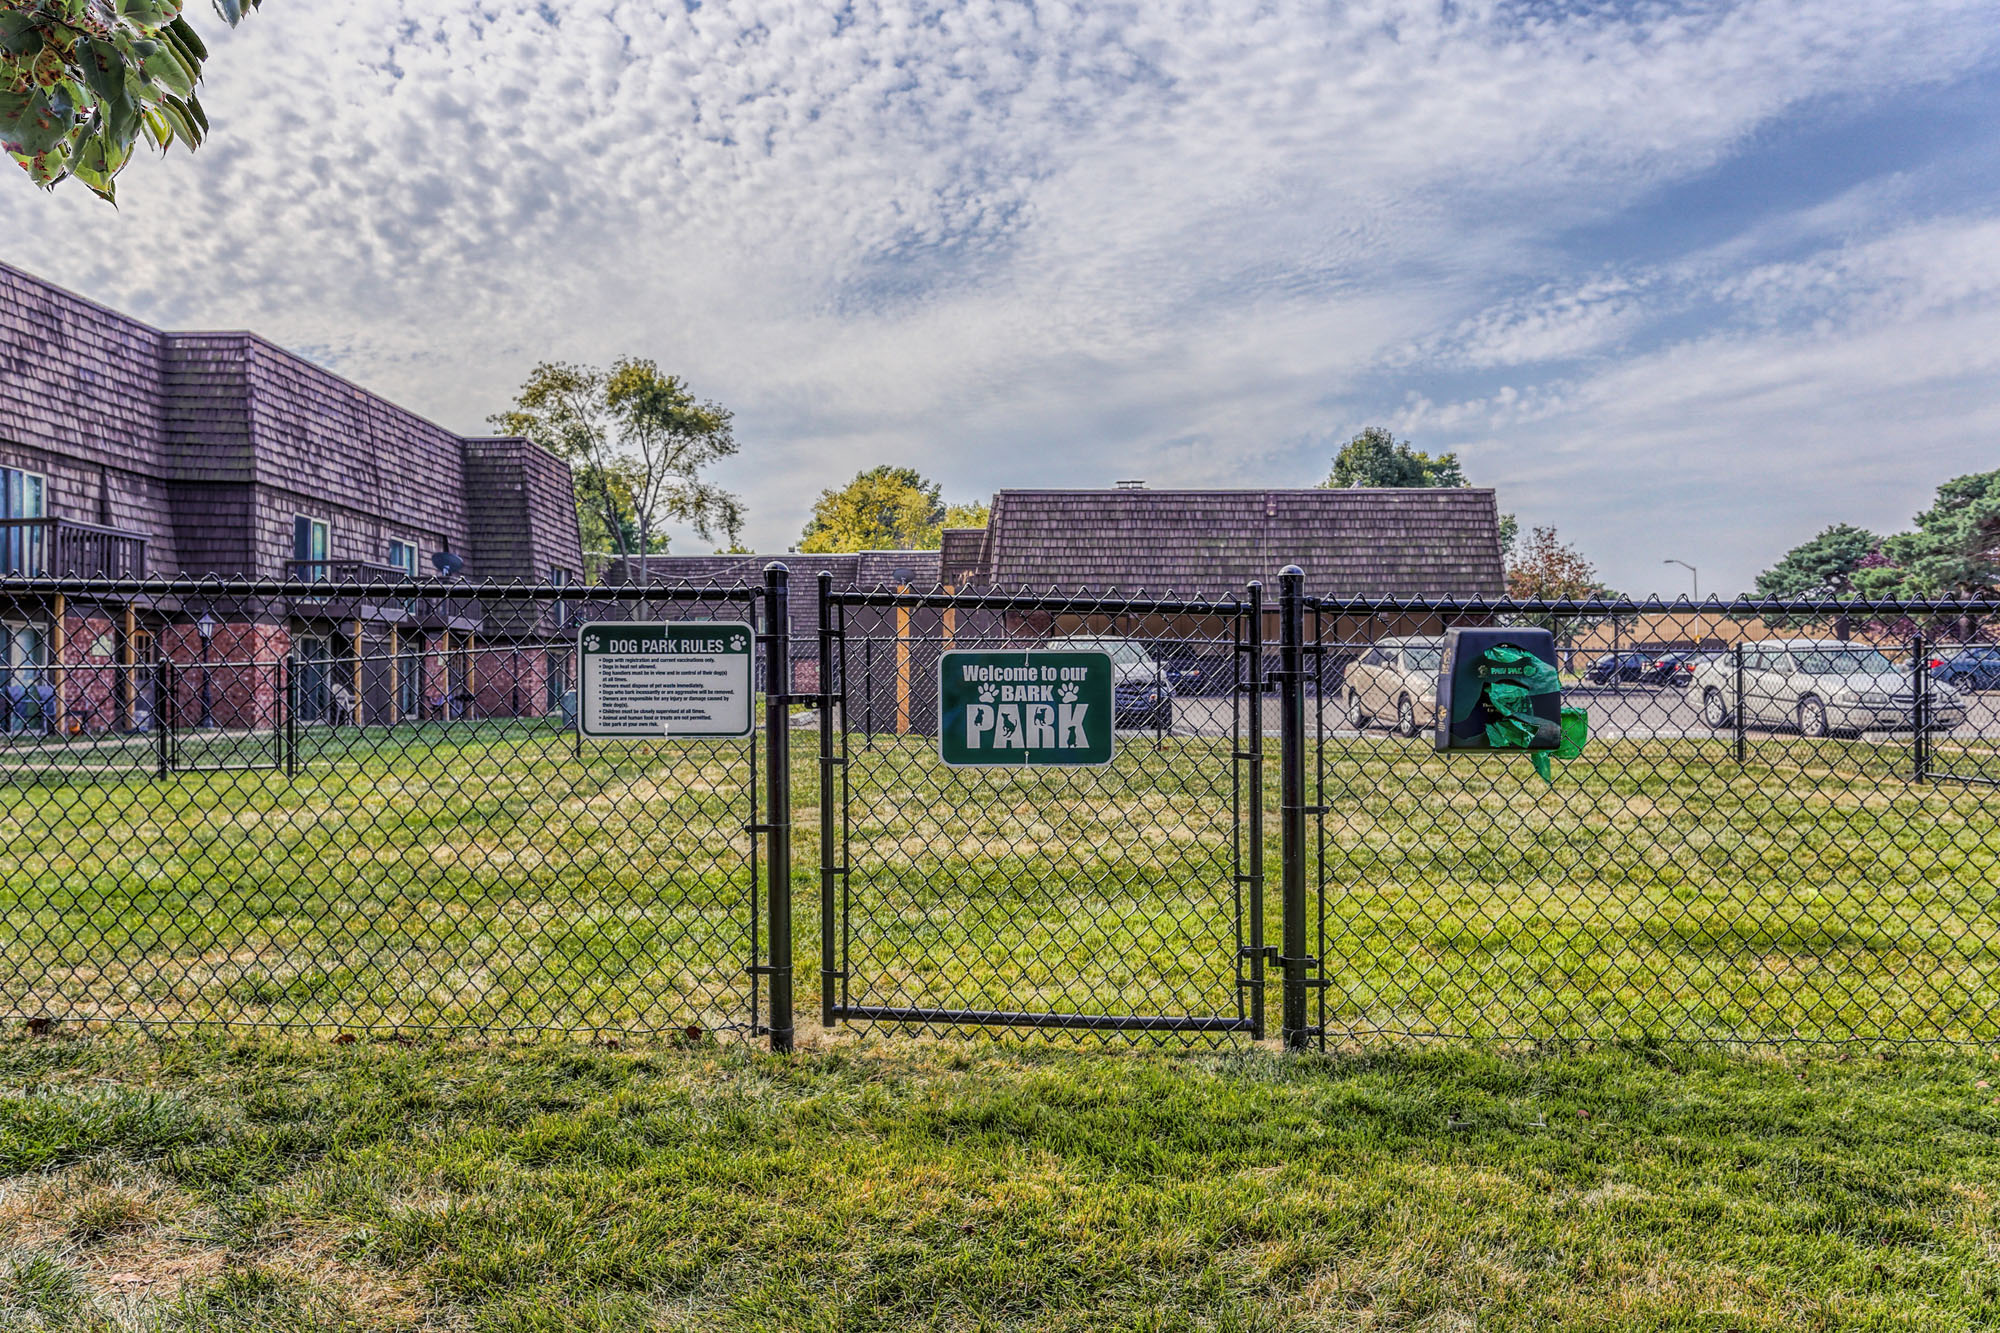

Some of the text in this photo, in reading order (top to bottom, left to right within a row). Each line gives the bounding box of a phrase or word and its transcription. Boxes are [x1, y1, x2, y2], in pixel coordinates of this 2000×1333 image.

[610, 639, 724, 653] DOG PARK RULES
[963, 665, 1087, 681] Welcome to our
[1002, 685, 1054, 702] BARK
[967, 704, 1090, 748] PARK
